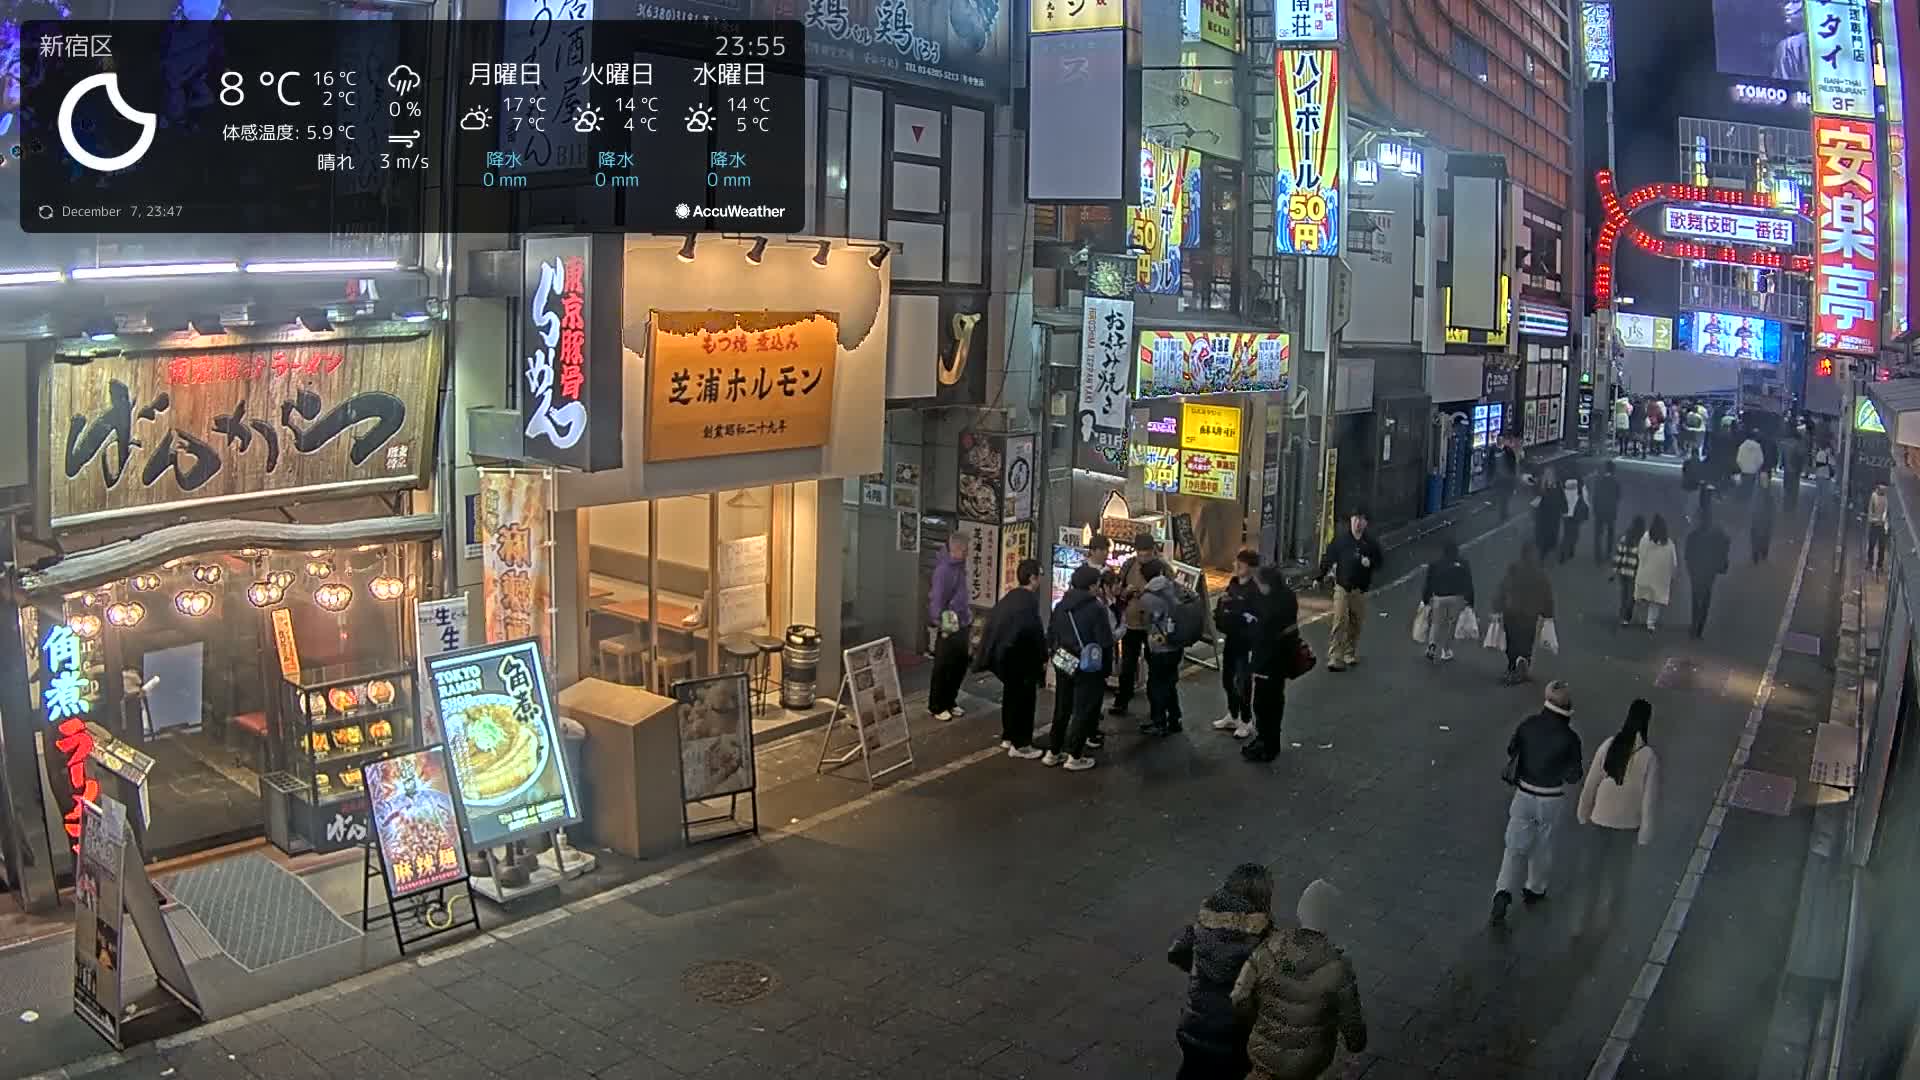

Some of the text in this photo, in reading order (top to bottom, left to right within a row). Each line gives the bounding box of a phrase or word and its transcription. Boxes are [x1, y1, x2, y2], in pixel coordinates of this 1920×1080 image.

[1736, 84, 1788, 102] TOMOO
[1832, 97, 1855, 111] 3F
[1296, 53, 1321, 190] ハイボール
[1289, 195, 1326, 221] 50
[1133, 218, 1156, 250] 50
[1295, 223, 1320, 250] 円
[1670, 211, 1789, 242] 歌舞伎町一番街
[1818, 126, 1875, 331] 安楽亭
[560, 256, 585, 400] 東京豚骨
[1098, 309, 1126, 415] お好み焼き
[668, 366, 823, 405] 芝浦ホルモン
[972, 528, 983, 600] 芝浦ホルモン
[434, 664, 482, 686] TOKYO
[437, 678, 483, 699] RAMEN
